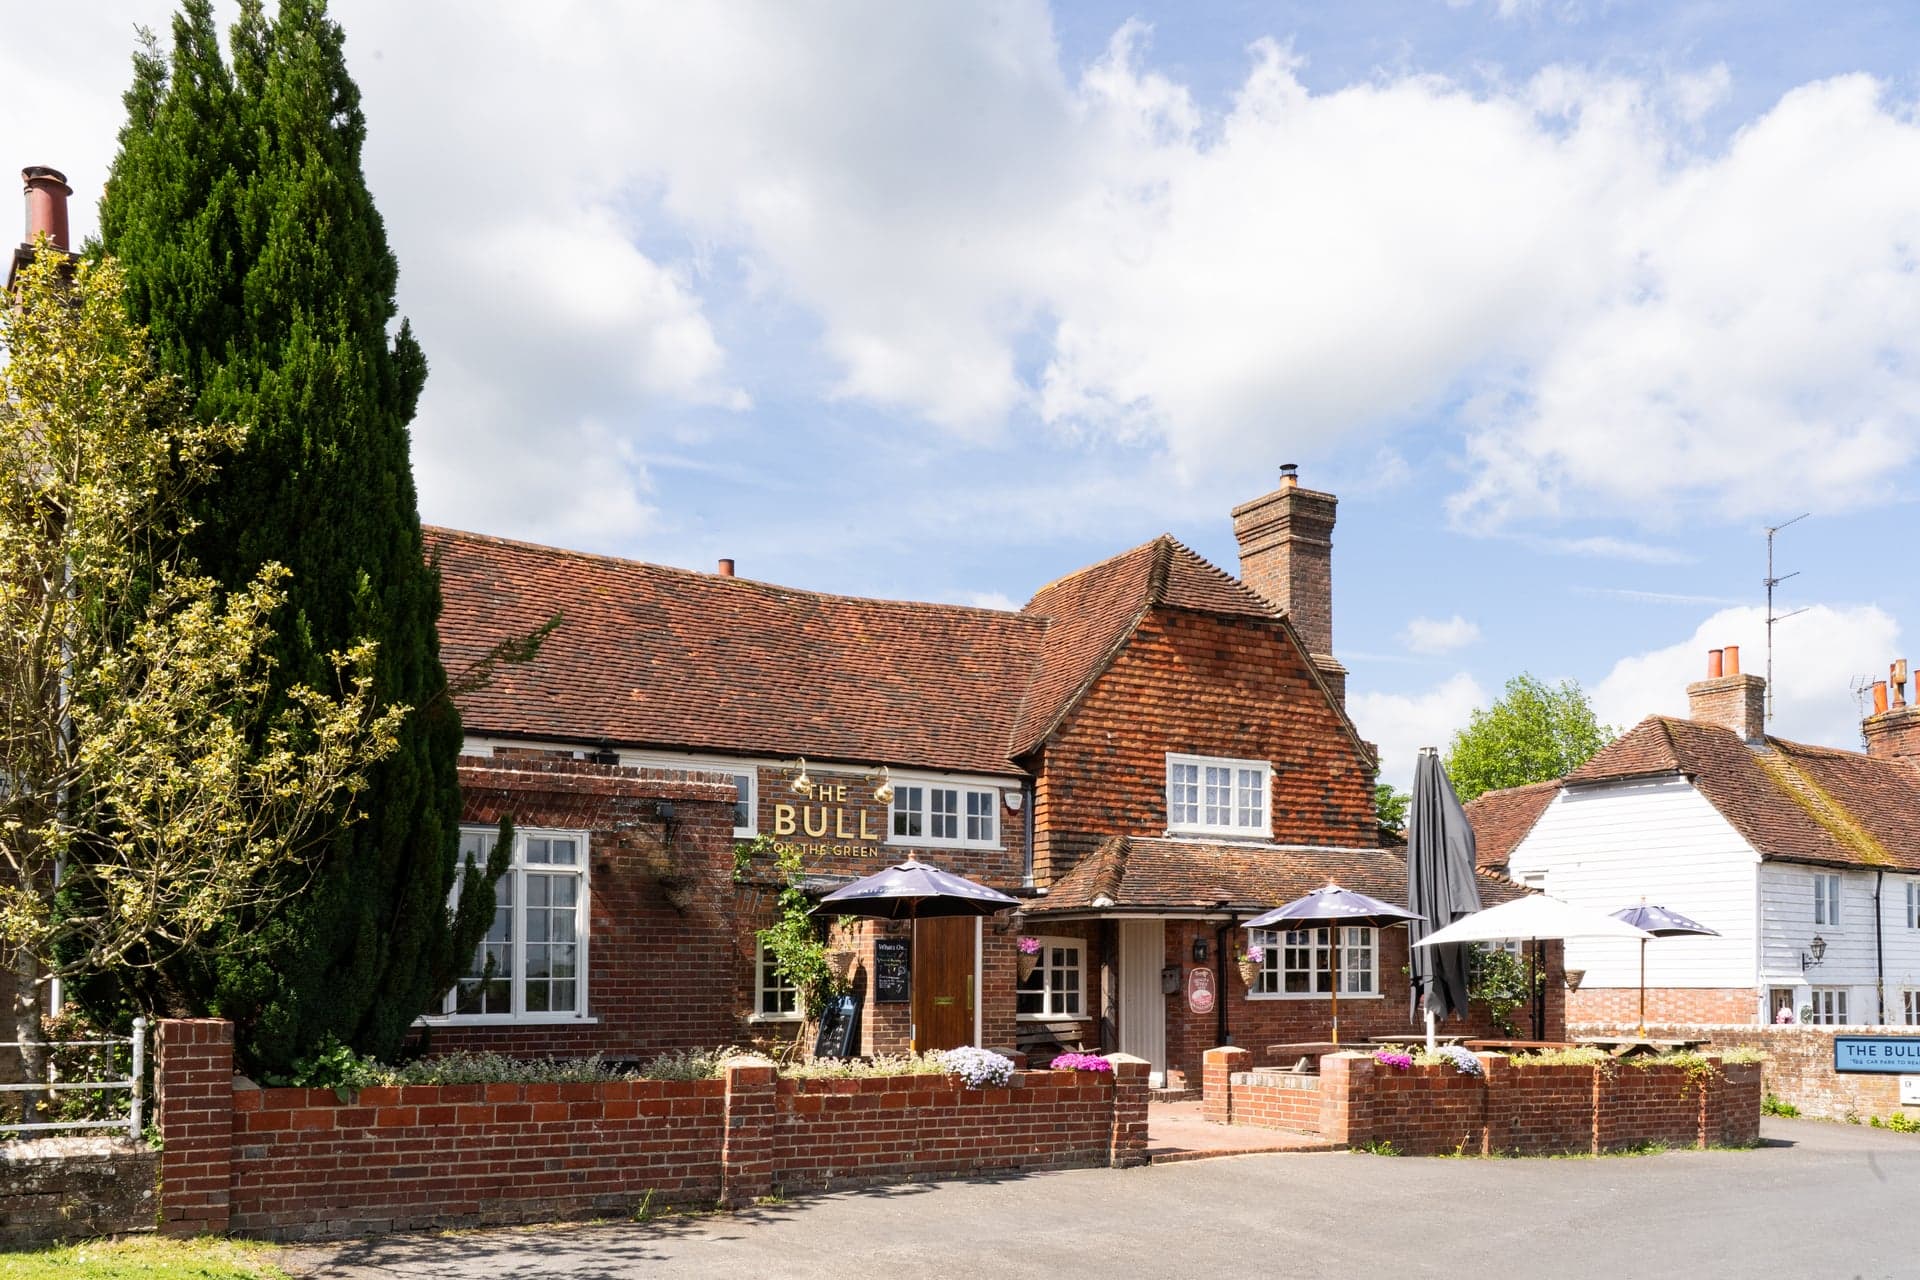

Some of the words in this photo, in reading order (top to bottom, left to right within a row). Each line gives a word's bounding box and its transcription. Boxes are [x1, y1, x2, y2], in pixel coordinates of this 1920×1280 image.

[806, 784, 847, 802] THE
[775, 804, 878, 840] BULL
[773, 842, 794, 854] ON
[800, 843, 826, 856] THE
[833, 845, 878, 857] GREEN
[1846, 1045, 1877, 1056] THE
